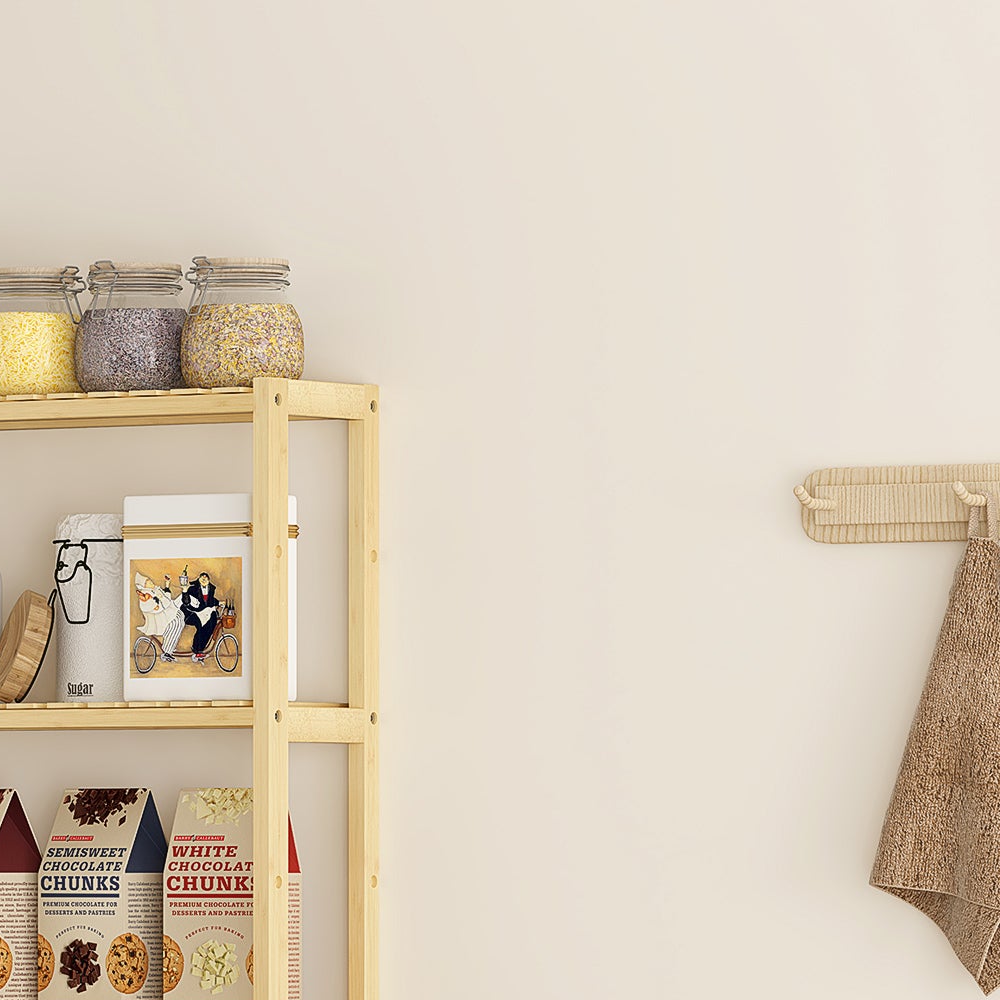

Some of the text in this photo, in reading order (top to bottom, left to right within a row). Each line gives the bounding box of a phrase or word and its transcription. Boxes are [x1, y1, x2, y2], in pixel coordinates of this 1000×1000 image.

[67, 682, 93, 696] Sugar
[47, 848, 127, 857] SEMISWEET
[172, 846, 238, 857] WHITE
[43, 862, 122, 871] CHOCOLATE
[168, 862, 253, 871] CHOCOLAT
[41, 876, 120, 891] CHUNKS
[185, 927, 209, 940] PERFECT
